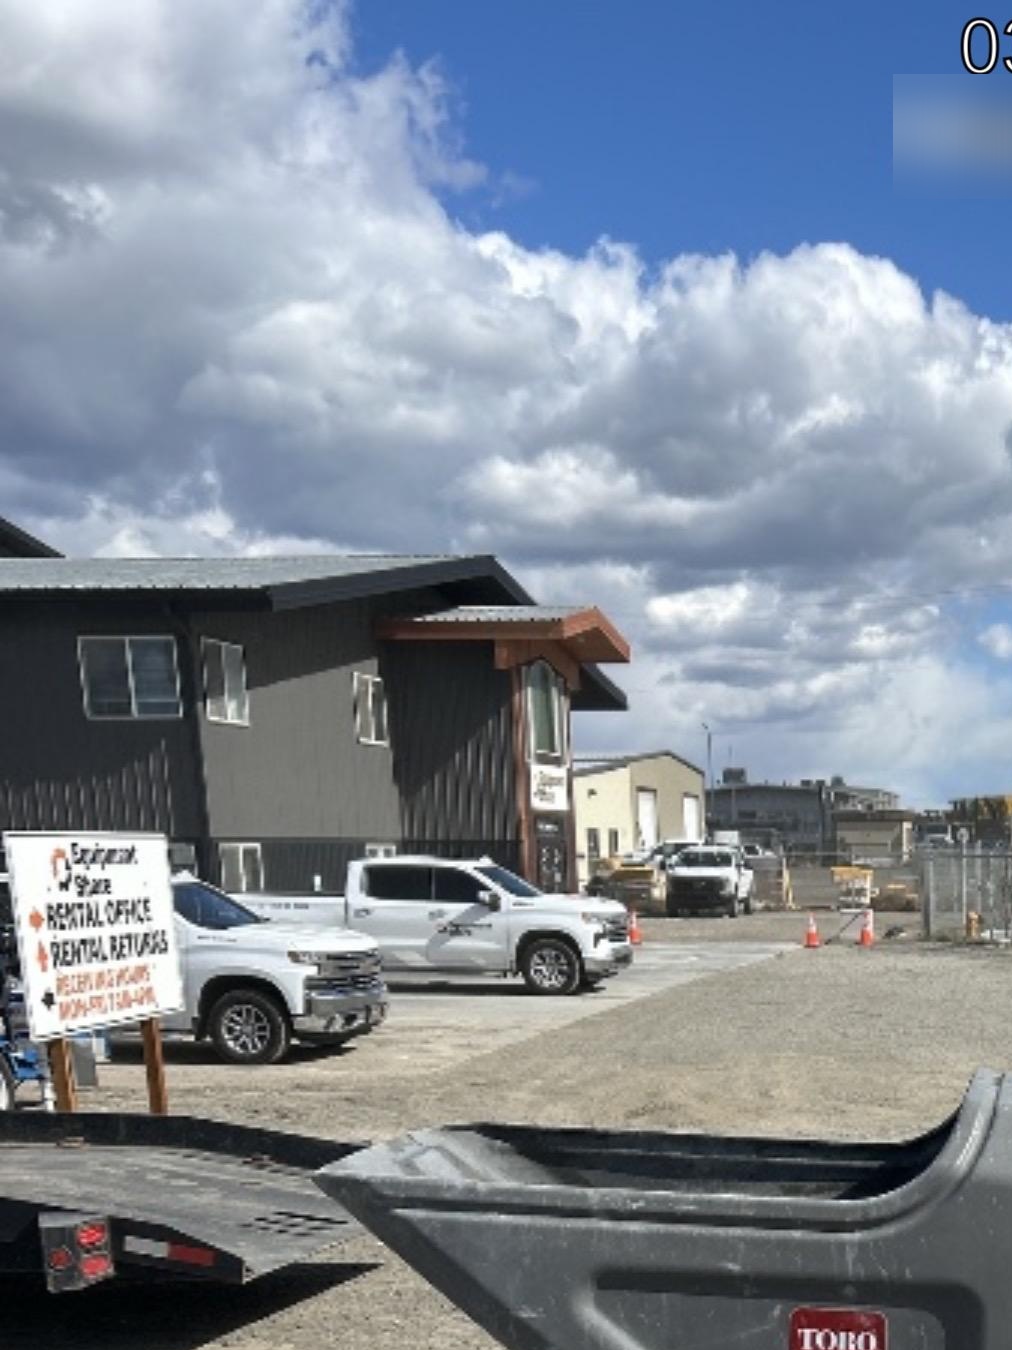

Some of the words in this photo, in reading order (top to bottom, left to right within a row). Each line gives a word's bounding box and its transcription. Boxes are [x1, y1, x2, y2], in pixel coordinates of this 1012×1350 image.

[71, 842, 138, 870] Equipment
[75, 875, 111, 896] Share
[47, 901, 104, 930] RENTAL
[105, 898, 152, 926] OFFICE
[51, 935, 108, 968] RENTAL
[110, 930, 168, 961] RETURNS
